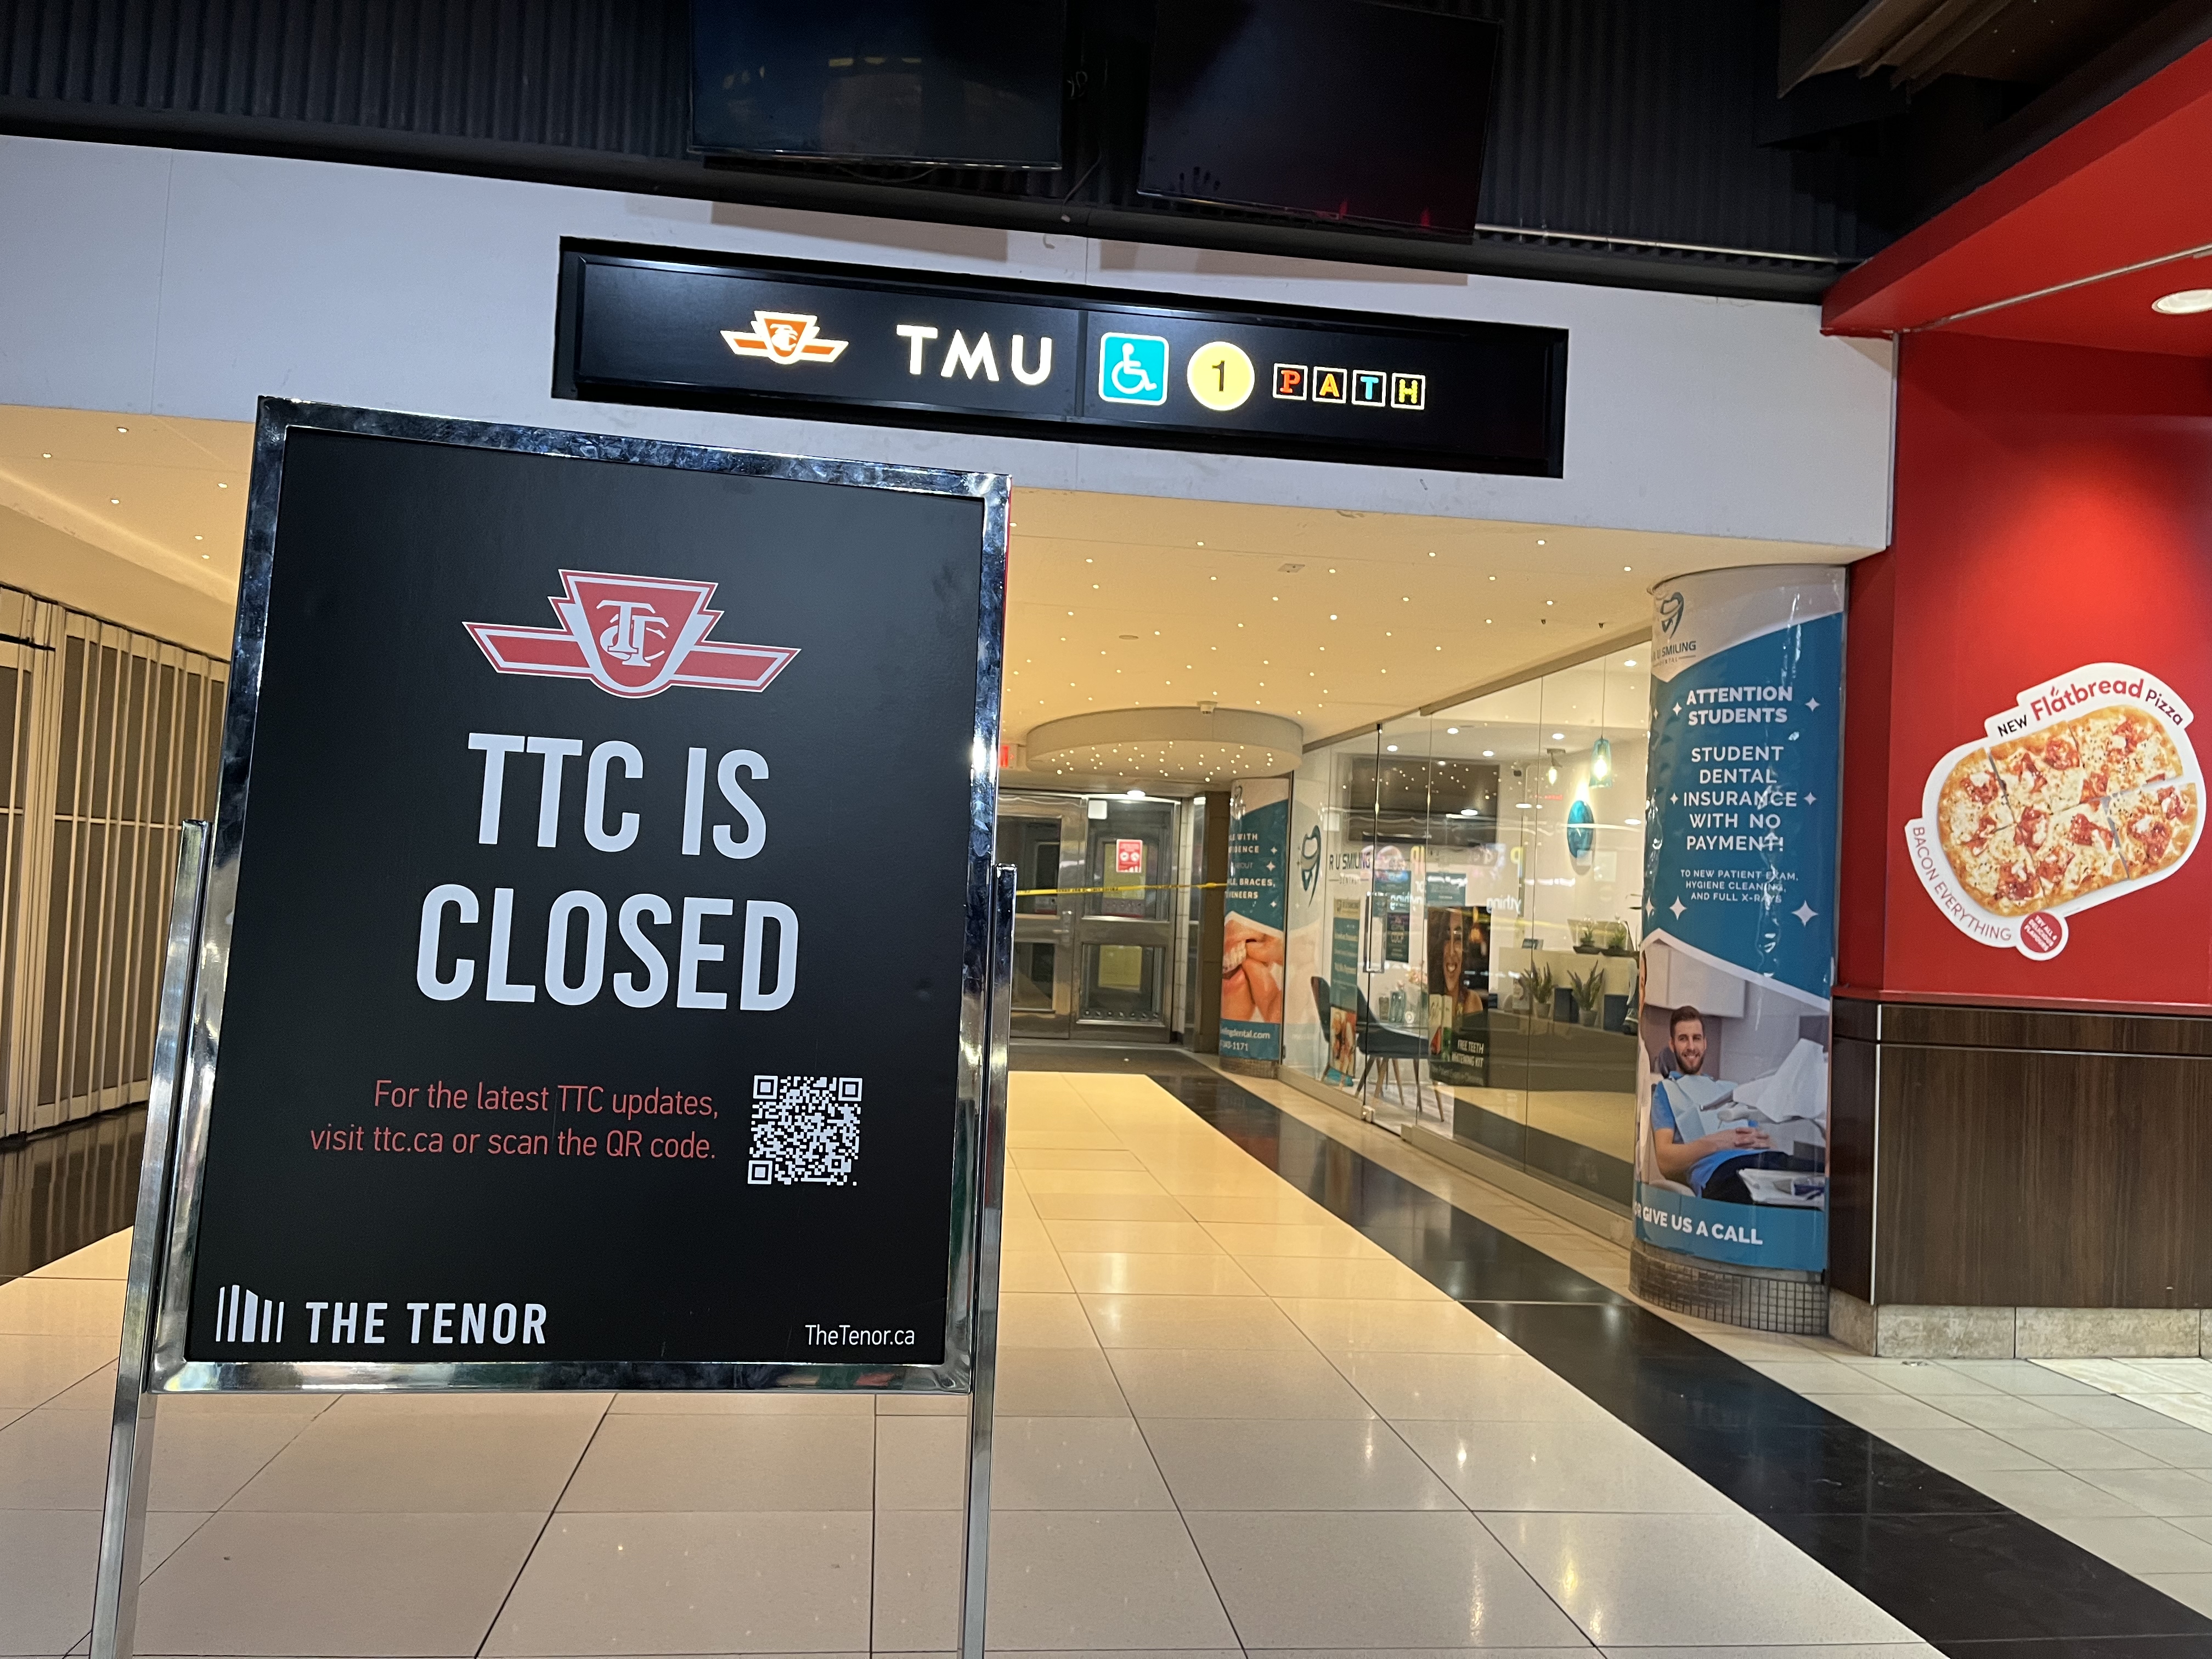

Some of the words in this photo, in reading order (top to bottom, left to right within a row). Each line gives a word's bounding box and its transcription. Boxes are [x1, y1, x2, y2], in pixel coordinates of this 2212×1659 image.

[896, 324, 1052, 385] TMU
[1211, 360, 1225, 392] 1
[1280, 369, 1418, 404] PATH
[1661, 641, 1696, 657] SMILING
[1686, 686, 1793, 706] ATTENTION
[1688, 707, 1788, 726] STUDENTS
[1997, 714, 2028, 737] NEW
[2030, 678, 2145, 721] Flatbread
[2145, 689, 2183, 726] Pizza
[1691, 745, 1784, 763] STUDENT
[1700, 768, 1778, 785] DENTAL
[468, 732, 644, 853] TTC
[682, 746, 769, 860] IS
[1683, 791, 1798, 807] INSURANCE
[1689, 812, 1738, 828] WITH
[1749, 814, 1781, 829] NO
[1686, 834, 1784, 852] PAYMENT!
[1329, 854, 1334, 870] R
[1335, 853, 1340, 870] U
[1342, 851, 1371, 870] SMILING
[1680, 869, 1691, 877] TO
[1693, 870, 1715, 878] NEW
[1718, 870, 1762, 879] PATIENT
[1912, 827, 1939, 882] BACON
[1934, 881, 2012, 941] EVERYTHING
[1685, 880, 1725, 889] HYGIENE
[1690, 892, 1710, 901] AND
[1713, 893, 1739, 901] FULL
[416, 884, 799, 1011] CLOSED
[374, 1079, 419, 1109] For
[427, 1080, 468, 1109] the
[477, 1081, 549, 1111] latest
[558, 1085, 604, 1113] TTC
[612, 1087, 719, 1120] updates,
[310, 1123, 364, 1151] visit
[373, 1126, 442, 1153] ttc.ca
[452, 1132, 481, 1154] or
[488, 1135, 548, 1155] scan
[557, 1127, 597, 1157] the
[606, 1130, 643, 1158] QR
[650, 1131, 716, 1160] code.
[1643, 1206, 1668, 1228] GIVE
[1671, 1214, 1692, 1234] US
[1696, 1221, 1709, 1237] A
[1711, 1223, 1763, 1245] CALL
[305, 1302, 388, 1344] THE
[406, 1302, 547, 1345] TENOR
[805, 1324, 915, 1345] TheTenor.ca
